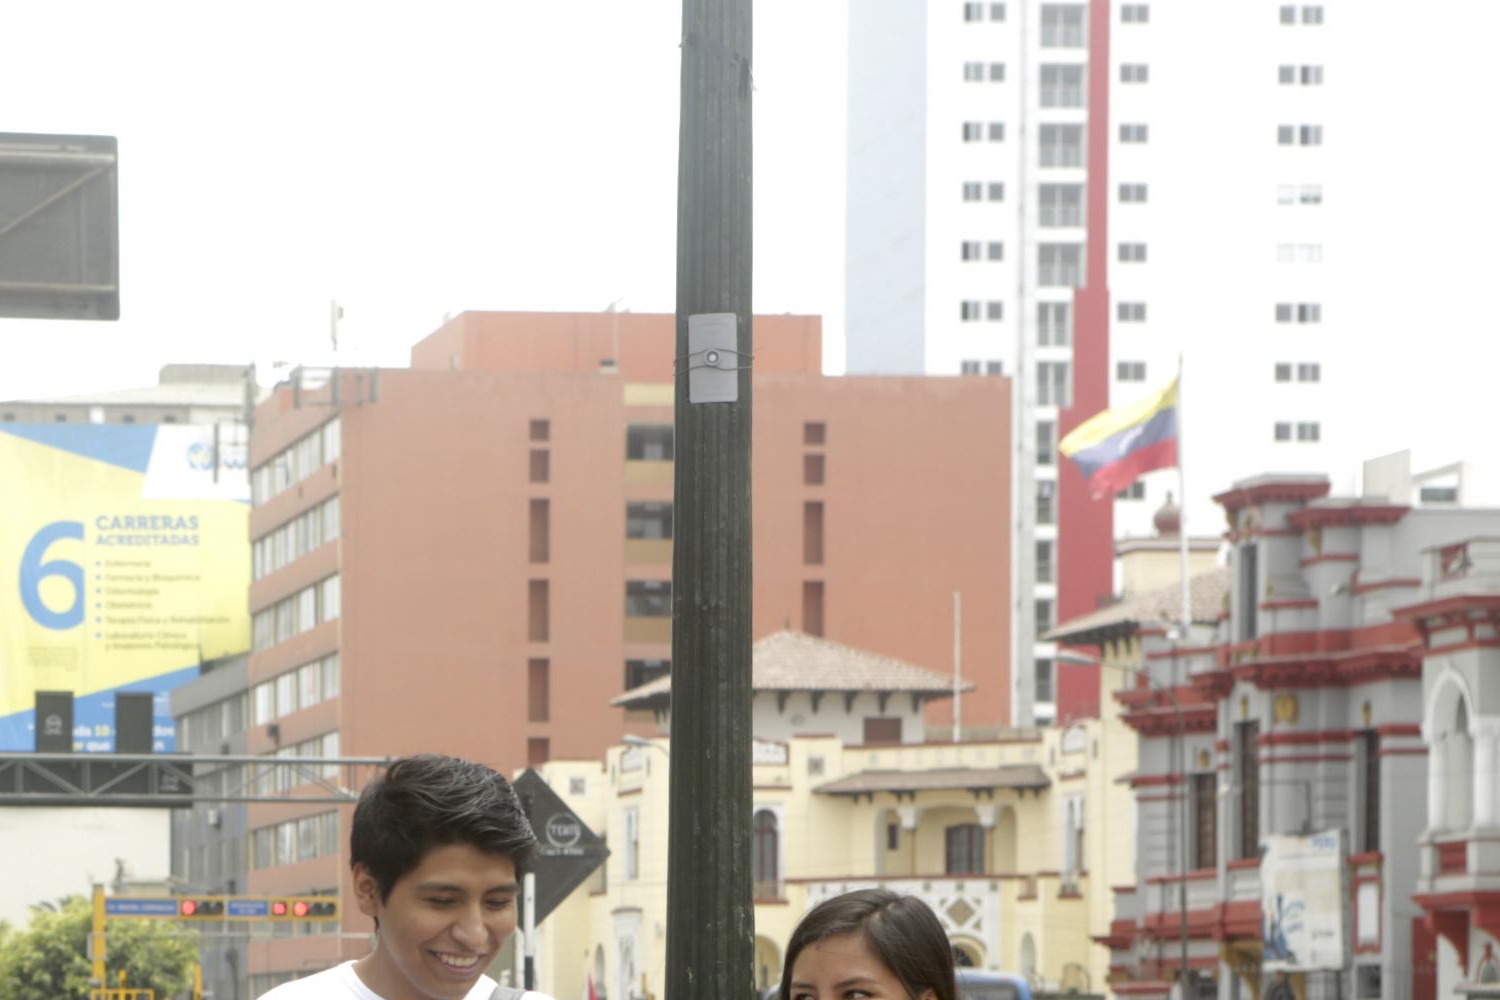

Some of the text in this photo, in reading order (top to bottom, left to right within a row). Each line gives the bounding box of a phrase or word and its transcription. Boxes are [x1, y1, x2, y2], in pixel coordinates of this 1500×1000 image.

[95, 515, 200, 531] CARRERAS
[95, 535, 200, 546] ACREDITADAS
[19, 520, 85, 630] 6
